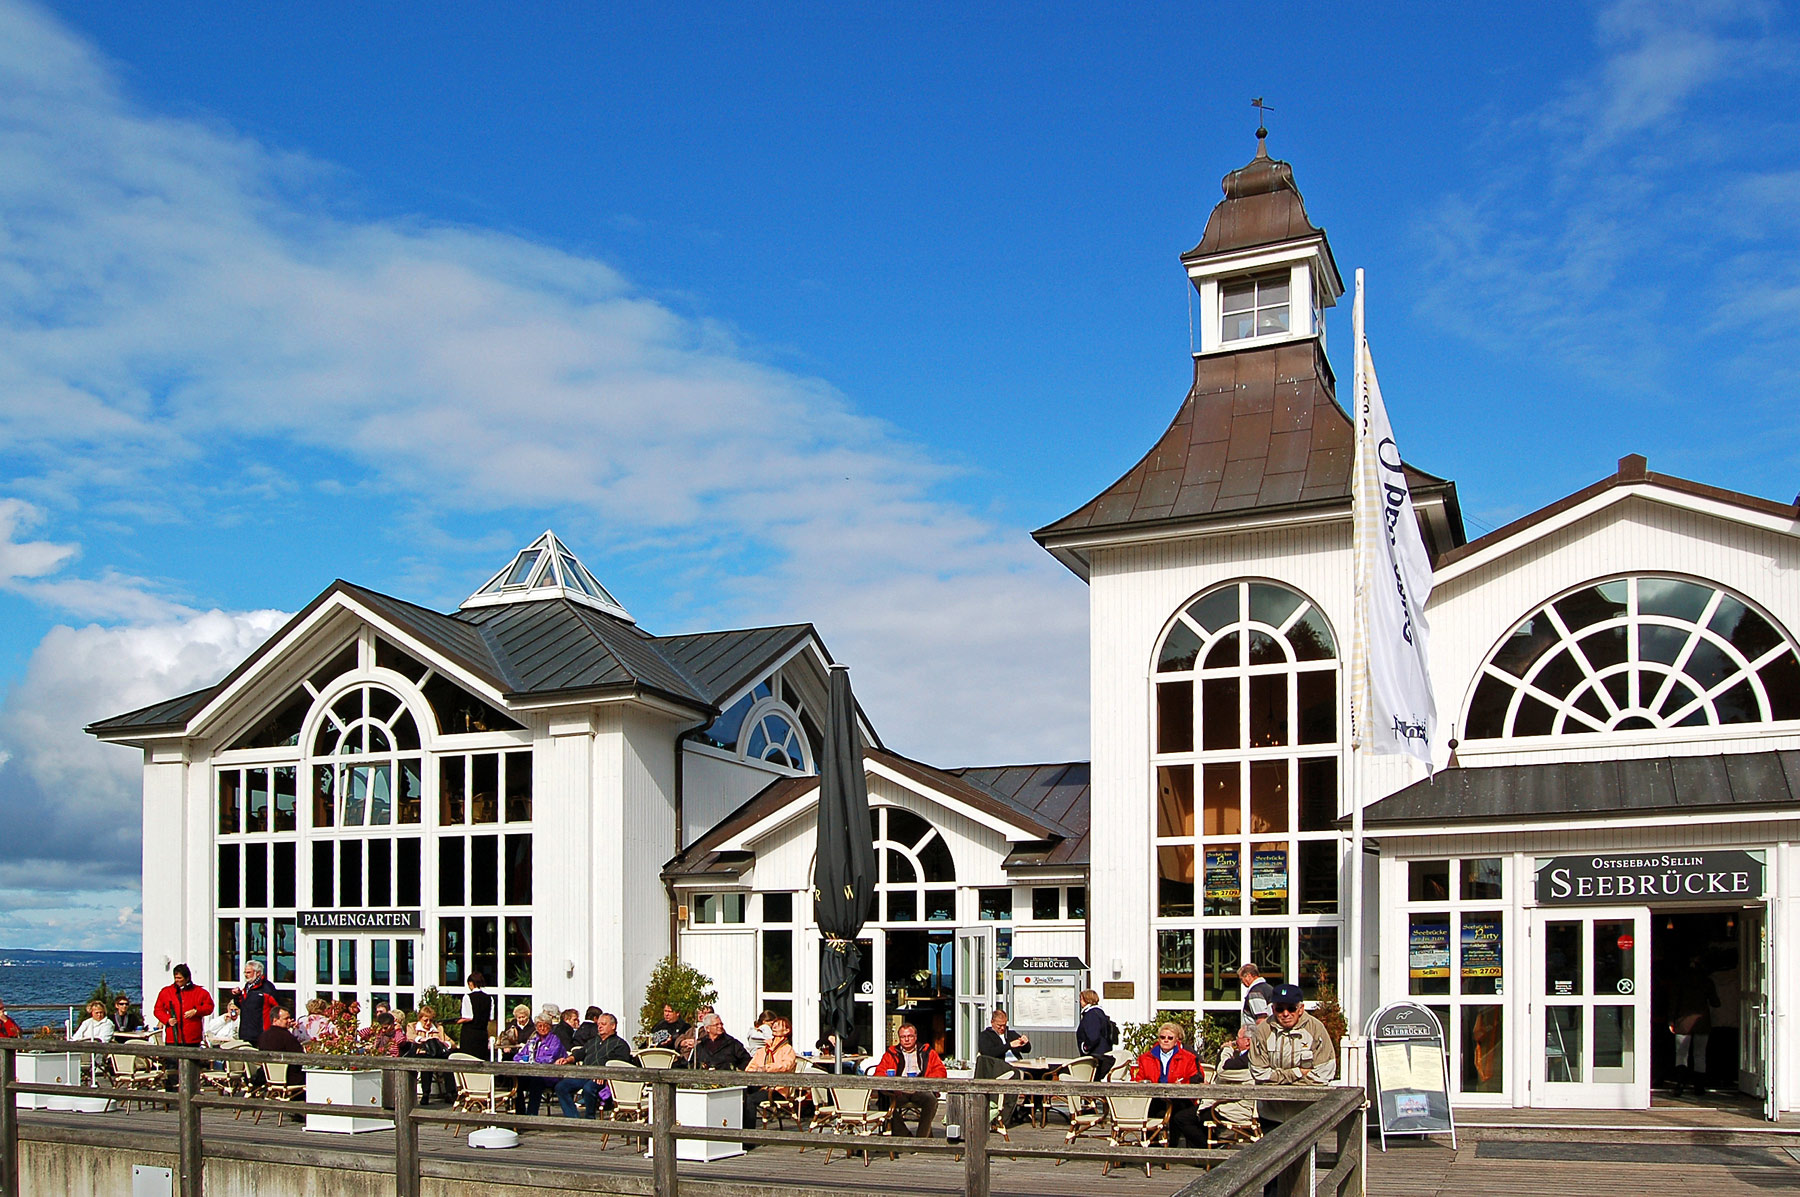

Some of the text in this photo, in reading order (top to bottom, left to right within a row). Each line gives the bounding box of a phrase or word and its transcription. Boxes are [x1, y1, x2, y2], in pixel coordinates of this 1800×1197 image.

[1216, 855, 1237, 867] Party
[1591, 855, 1704, 869] OSTSEEBAD SELLIN
[1550, 868, 1750, 898] SEEBRÜCKE
[304, 913, 411, 926] PALMENGARTEN
[1474, 928, 1500, 941] Party
[1023, 959, 1069, 968] SEEBRÜCKE
